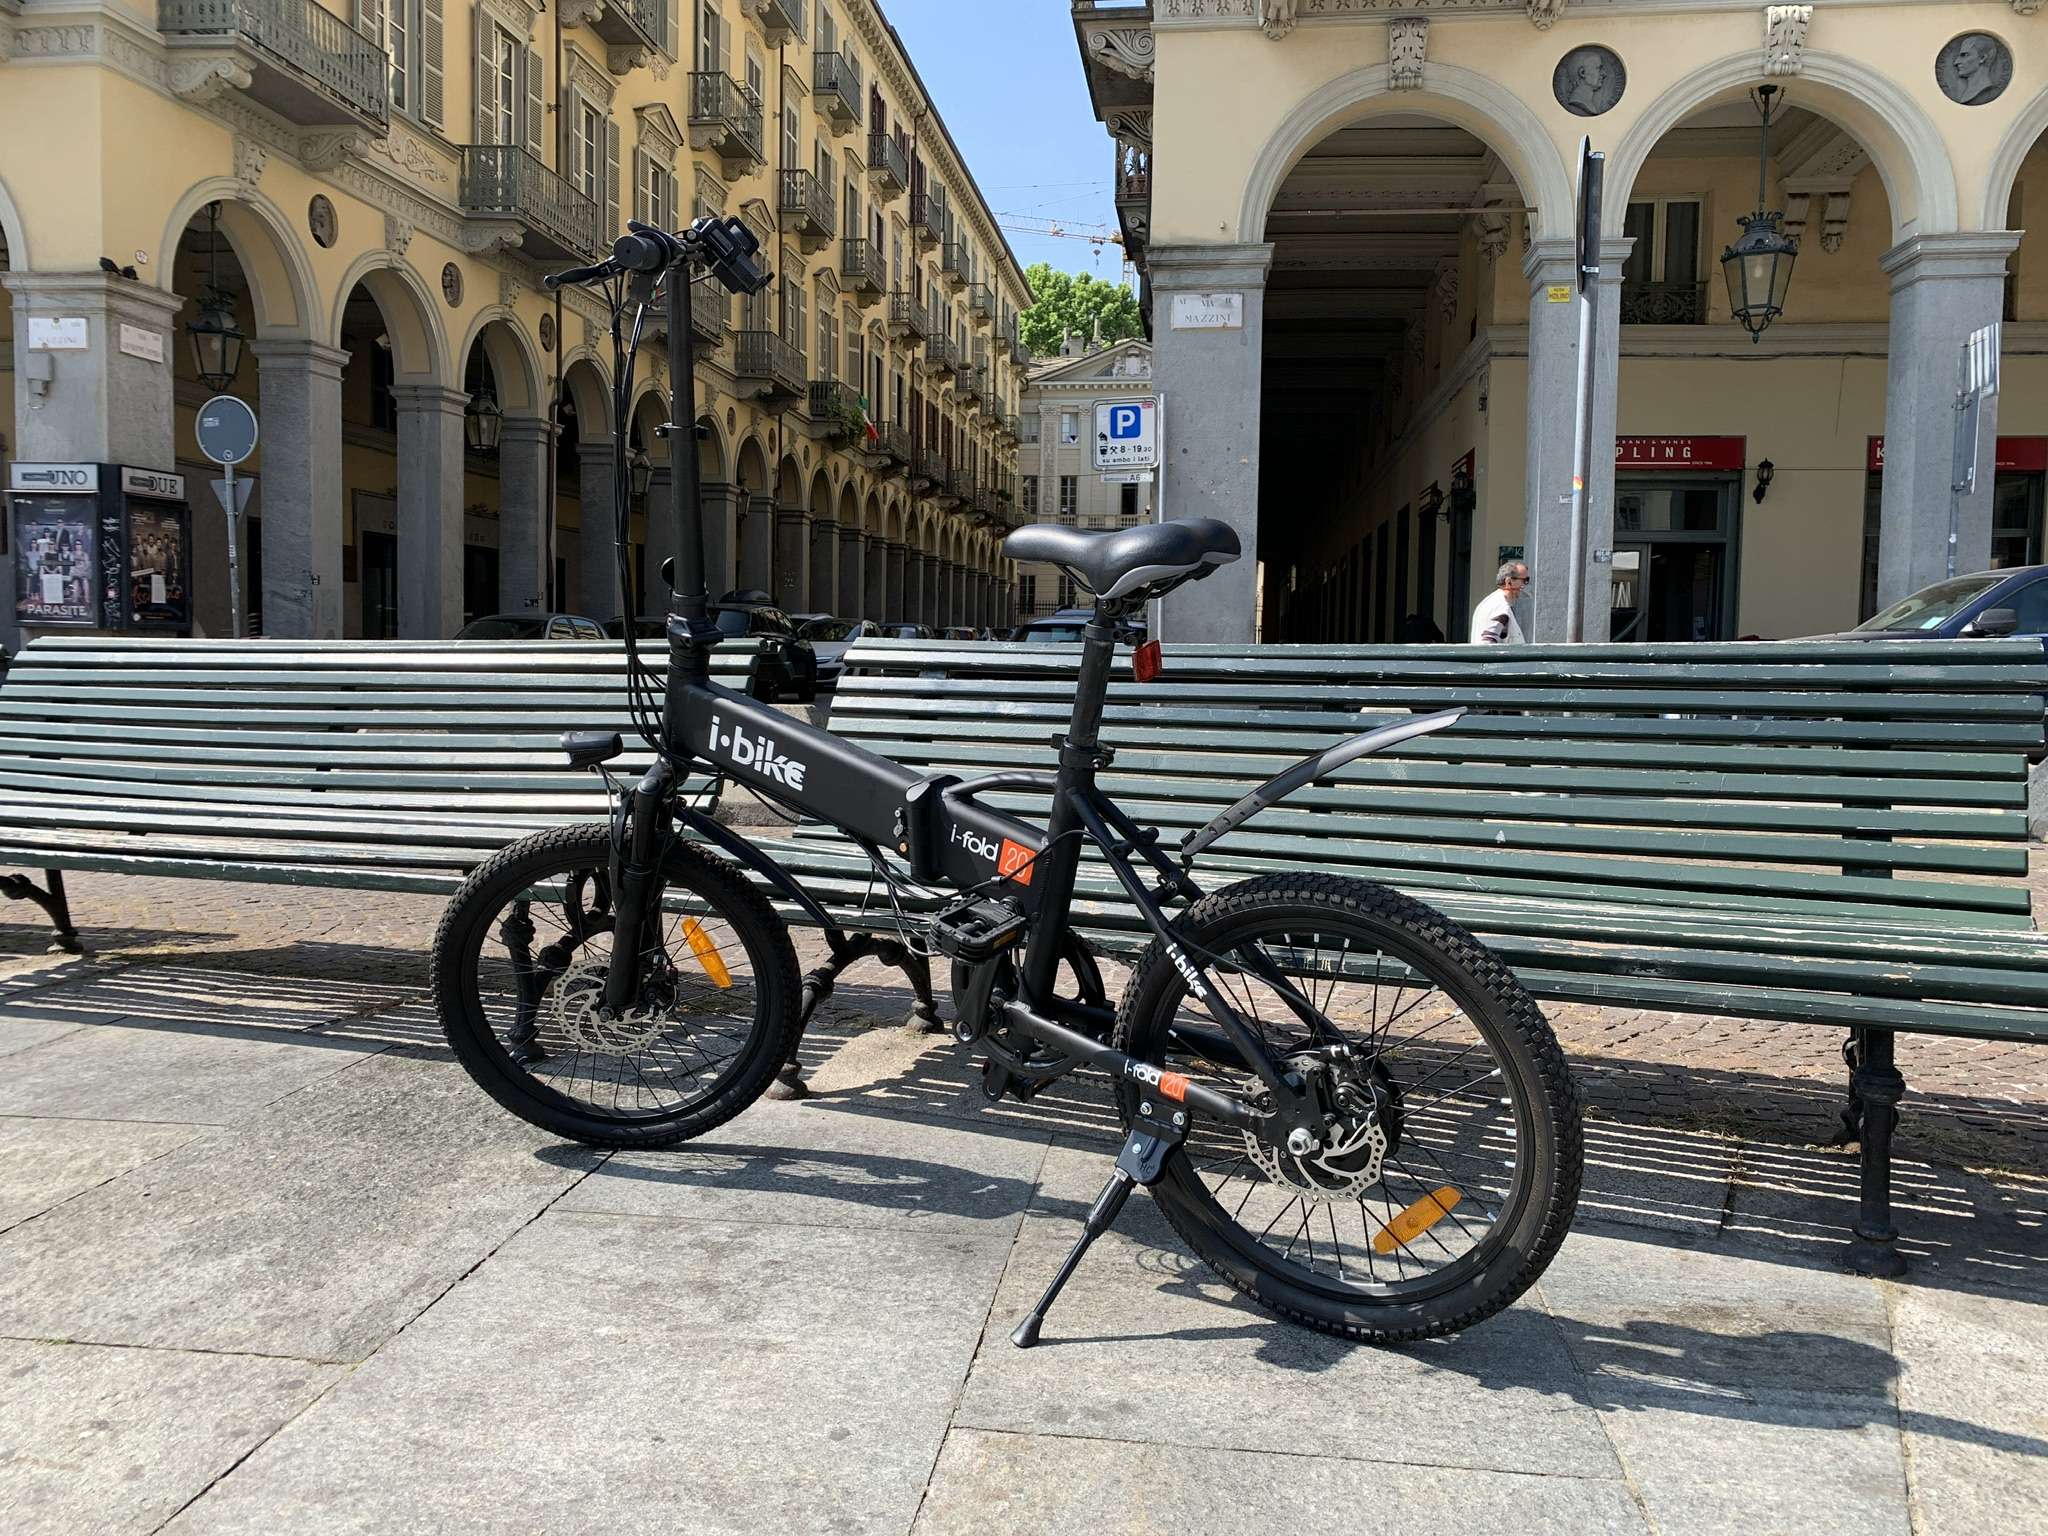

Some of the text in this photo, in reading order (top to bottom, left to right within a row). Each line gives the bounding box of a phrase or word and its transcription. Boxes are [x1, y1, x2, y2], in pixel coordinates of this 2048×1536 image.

[1184, 313, 1231, 323] MAZZINI
[1116, 409, 1136, 435] P
[1120, 445, 1126, 453] 8
[47, 470, 88, 485] UNO
[148, 476, 177, 494] DUE
[27, 603, 88, 616] PARASITE
[951, 824, 1029, 878] i-fold 20
[1124, 1059, 1183, 1097] i-fold 20
